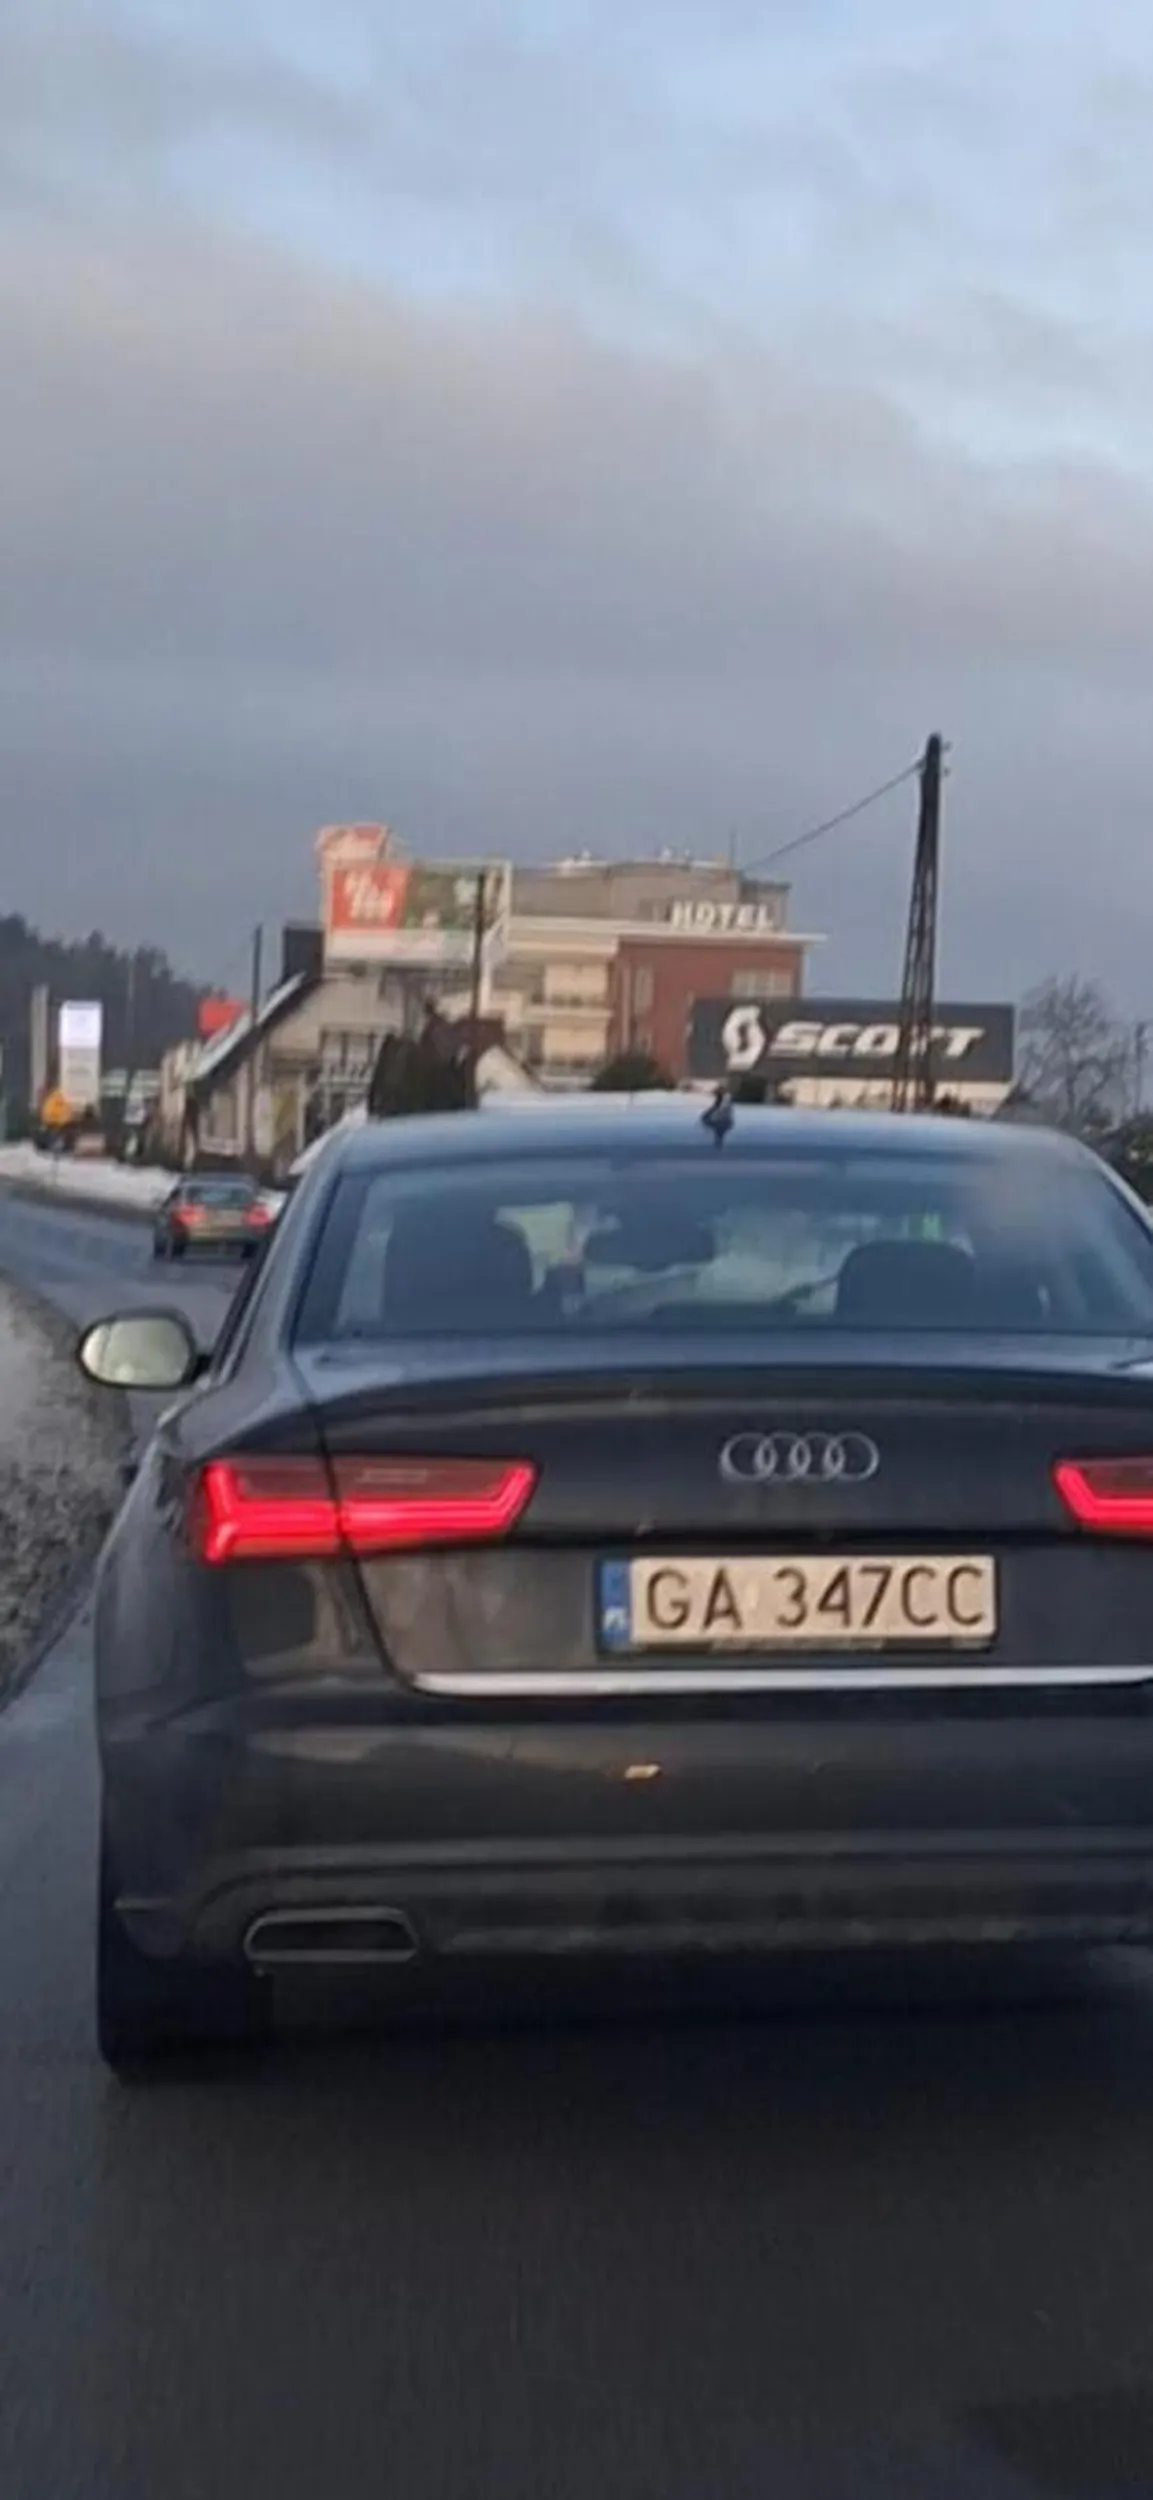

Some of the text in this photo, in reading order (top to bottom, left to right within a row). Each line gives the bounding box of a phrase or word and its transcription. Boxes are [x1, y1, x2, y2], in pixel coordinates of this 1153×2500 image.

[672, 900, 774, 931] HOTEL
[645, 1565, 984, 1630] GA 347CC
